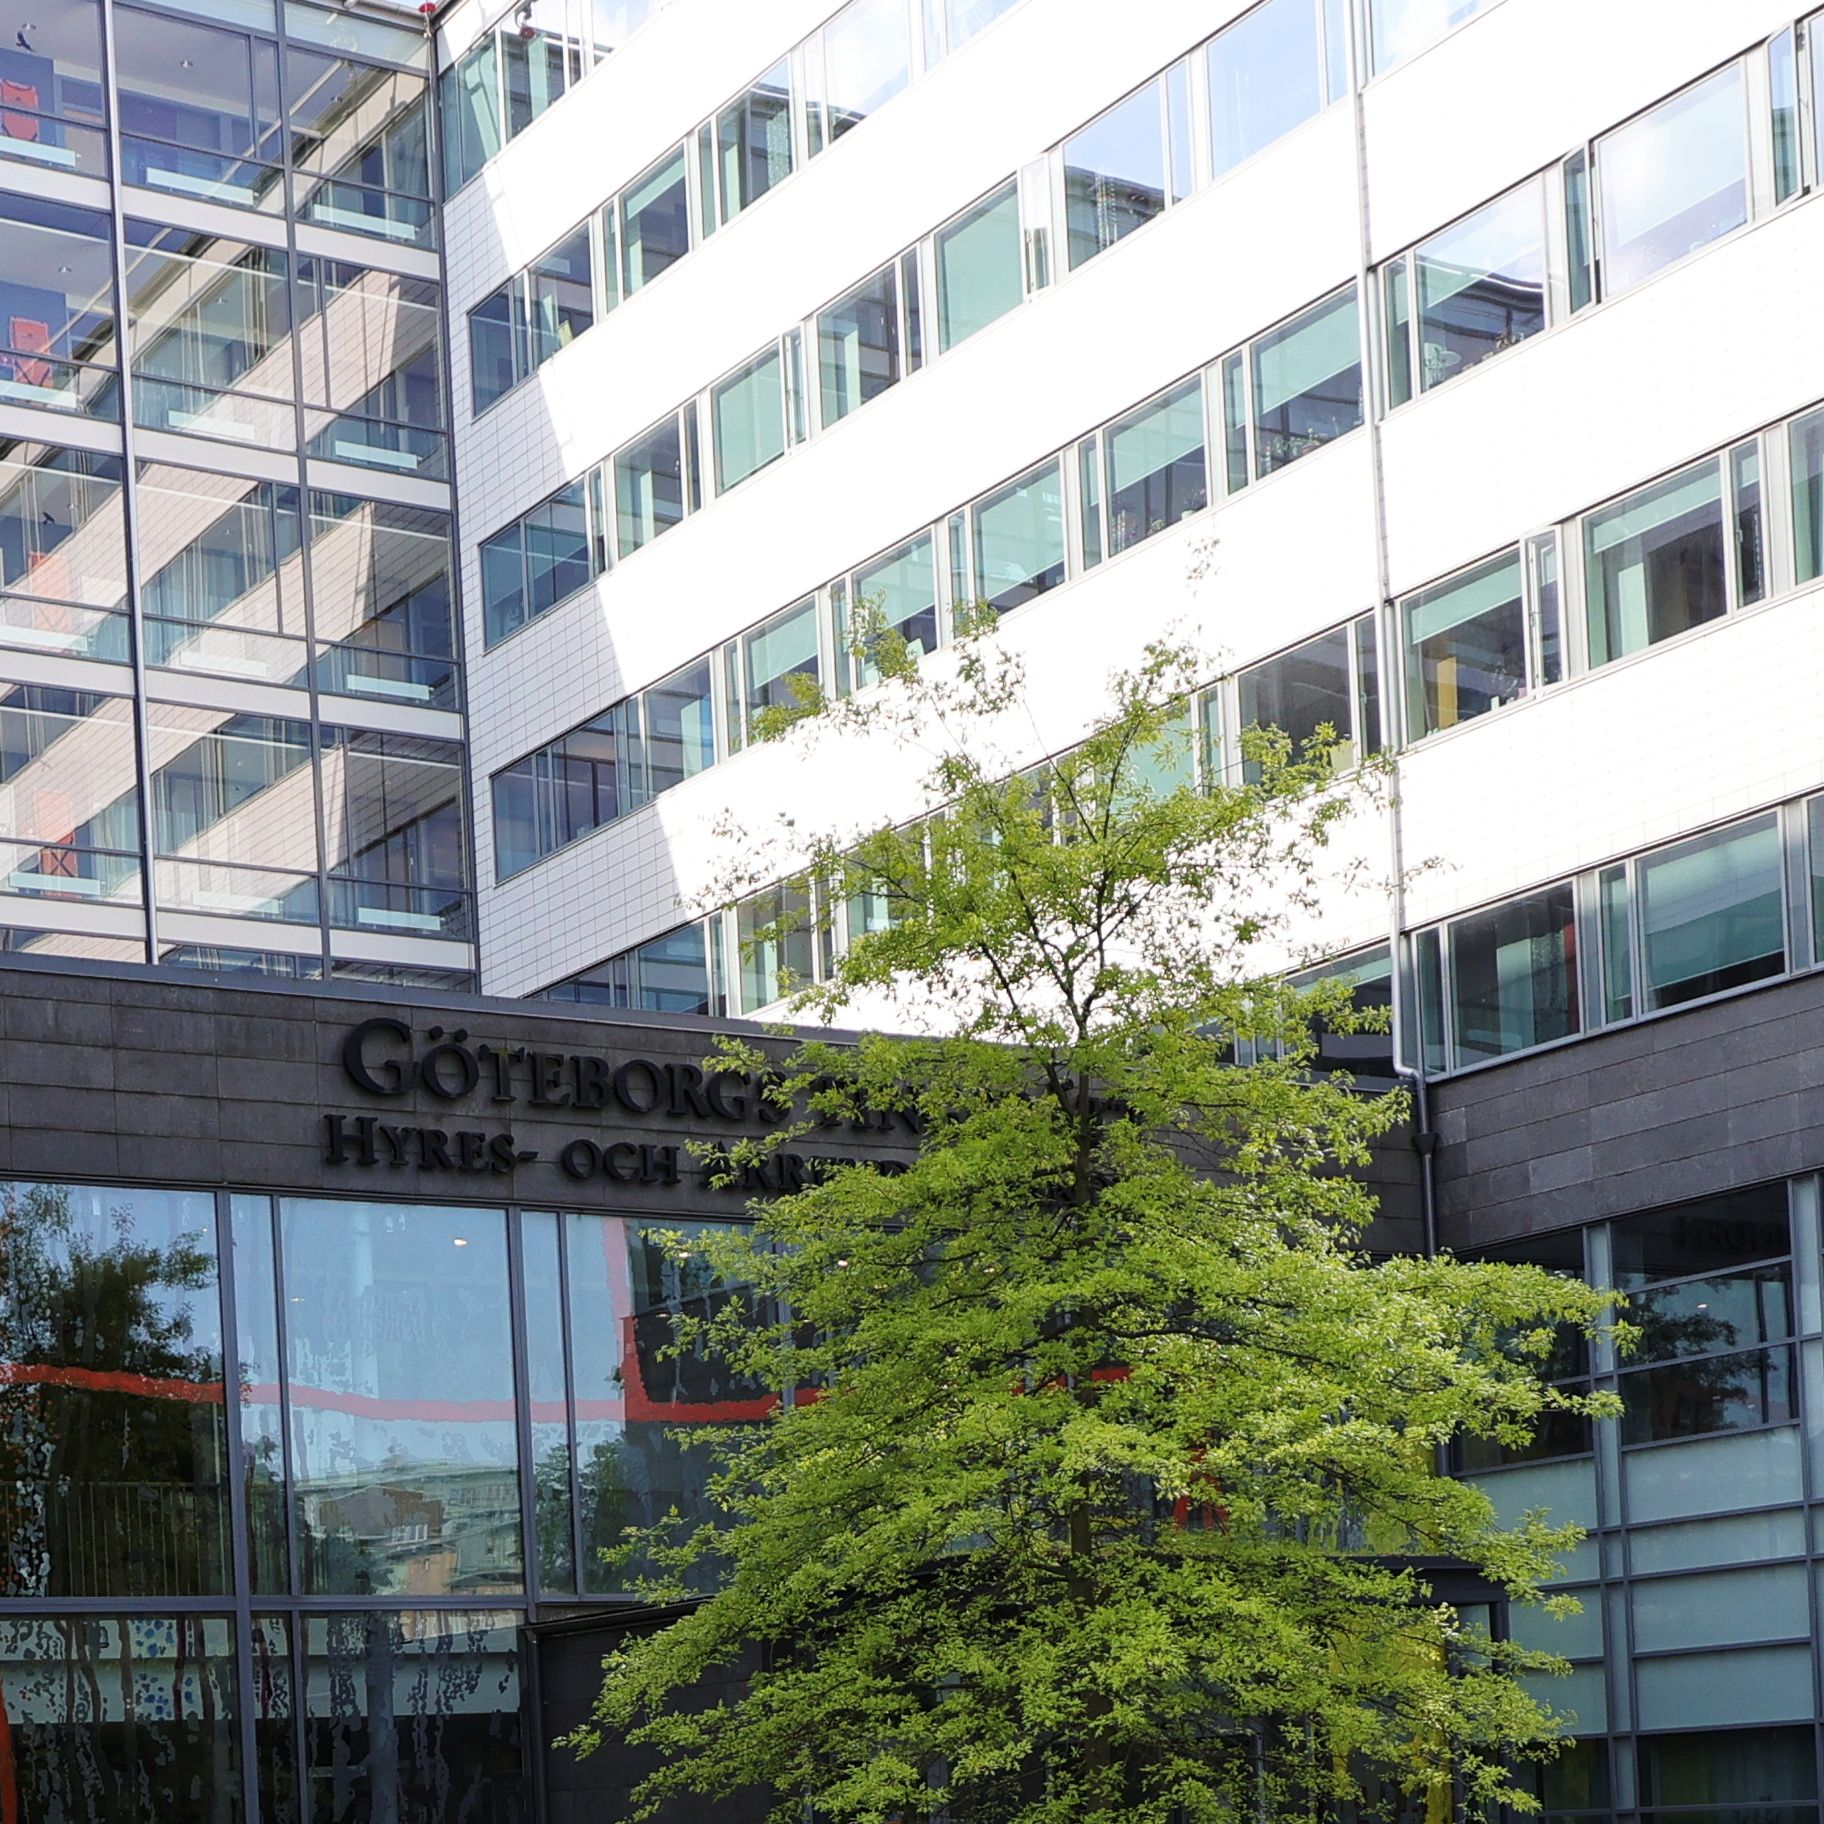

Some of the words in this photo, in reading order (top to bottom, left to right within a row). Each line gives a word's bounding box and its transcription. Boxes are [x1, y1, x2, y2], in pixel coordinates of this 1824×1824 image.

[343, 1016, 789, 1124] GÖTEBORGS
[325, 1113, 539, 1175] HYRES-
[560, 1138, 682, 1186] OCH
